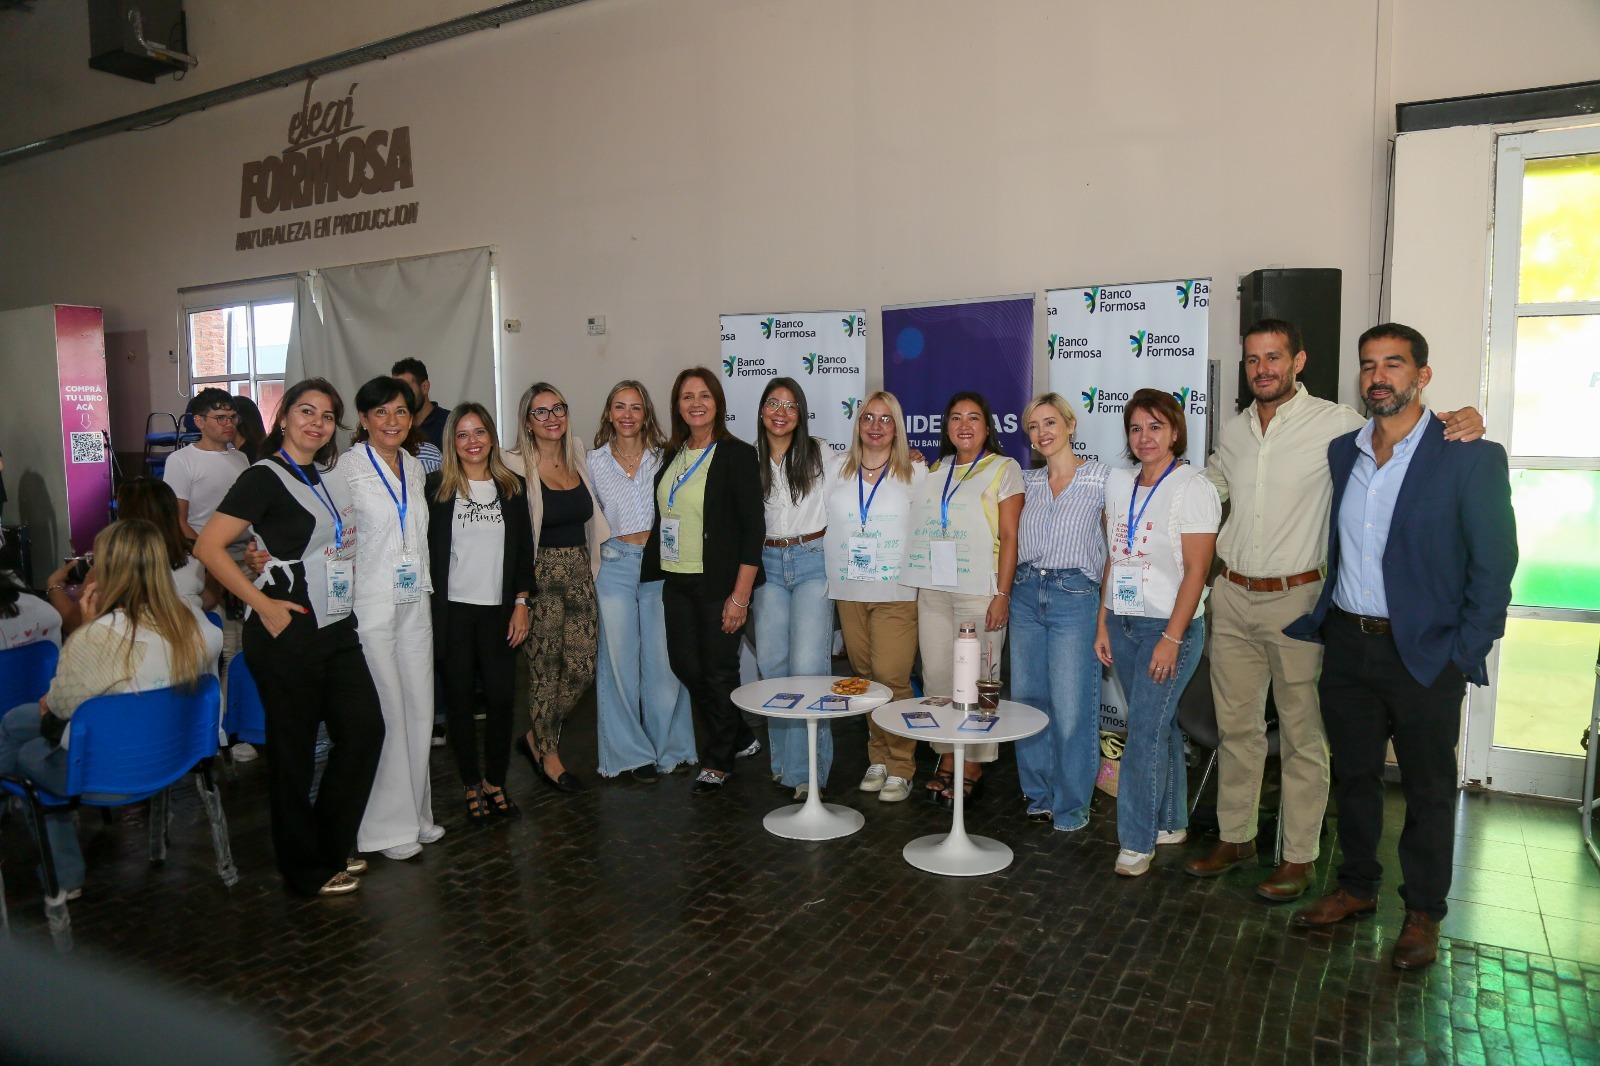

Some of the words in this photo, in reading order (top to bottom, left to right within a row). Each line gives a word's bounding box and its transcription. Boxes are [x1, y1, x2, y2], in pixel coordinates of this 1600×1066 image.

[239, 126, 415, 219] FORMOSA
[235, 220, 312, 252] NATURALEZA
[313, 214, 331, 239] EN
[1099, 289, 1132, 300] Banco
[1099, 300, 1146, 313] Formosa
[774, 319, 804, 329] Banco
[774, 329, 816, 339] Formosa
[1146, 332, 1180, 344] Banco
[1058, 336, 1088, 347] Banco
[1058, 348, 1102, 360] Formosa
[1146, 345, 1195, 357] Formosa
[737, 357, 765, 367] Banco
[817, 354, 847, 364] Banco
[737, 367, 778, 377] Formosa
[817, 365, 860, 375] Formosa
[1098, 389, 1129, 401] Banco
[76, 402, 94, 411] ACÁ
[1097, 402, 1124, 413] Form
[908, 439, 920, 447] TU
[921, 439, 941, 448] BAN
[1070, 441, 1086, 450] nco
[1100, 704, 1118, 714] nco
